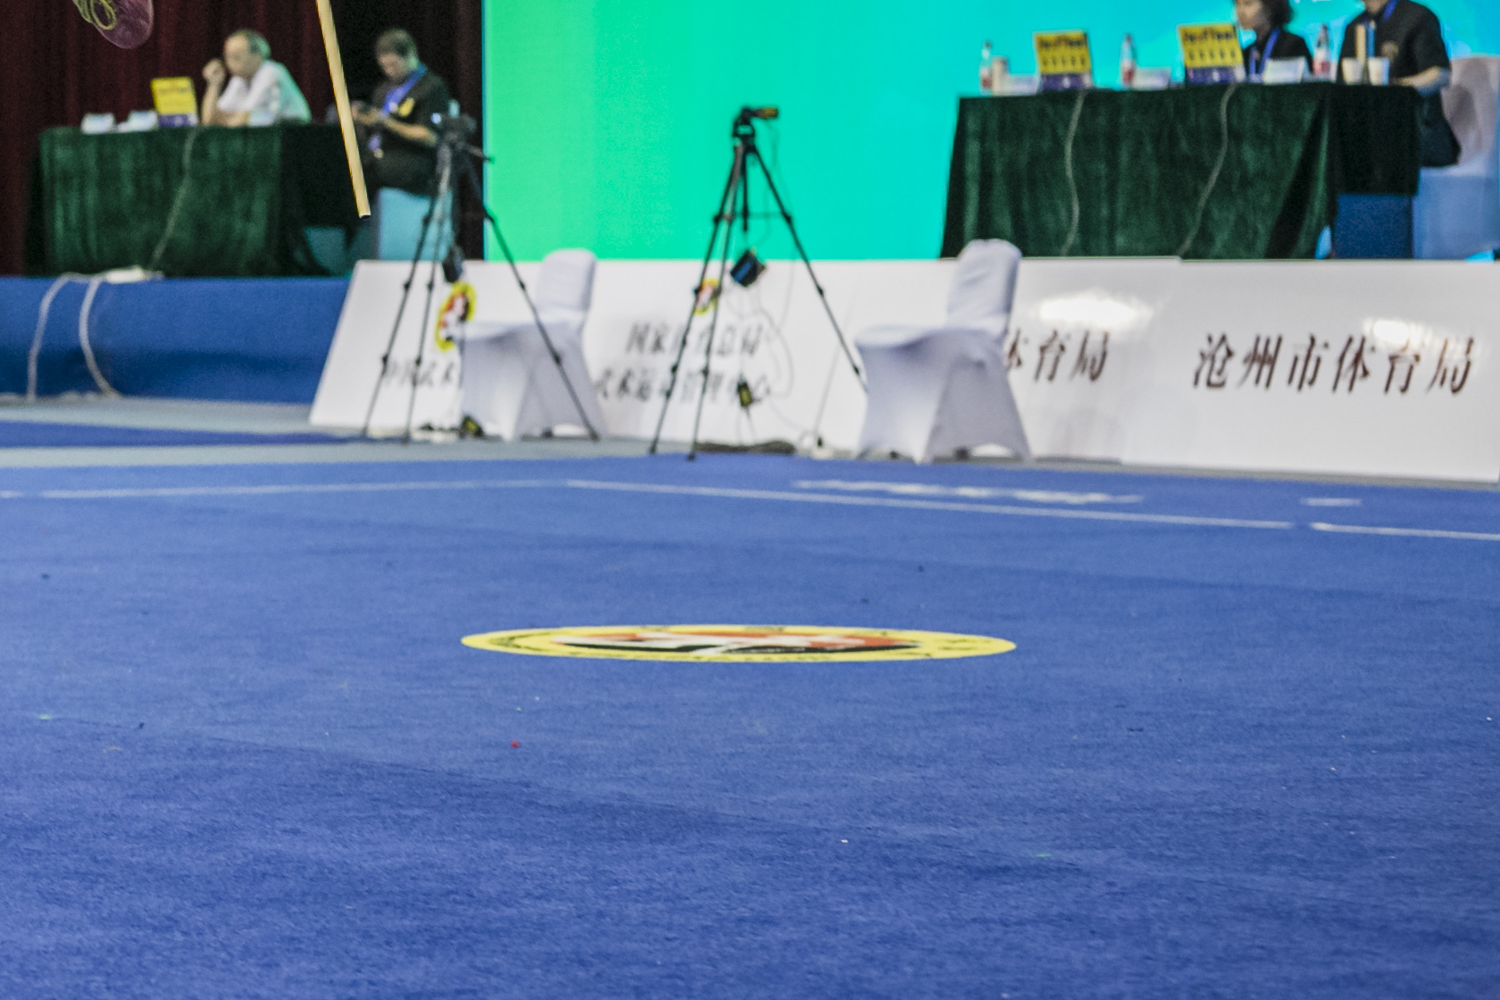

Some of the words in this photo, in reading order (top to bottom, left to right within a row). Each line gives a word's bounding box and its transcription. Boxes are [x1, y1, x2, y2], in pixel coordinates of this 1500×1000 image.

[1193, 331, 1475, 396] 沧州市体育局
